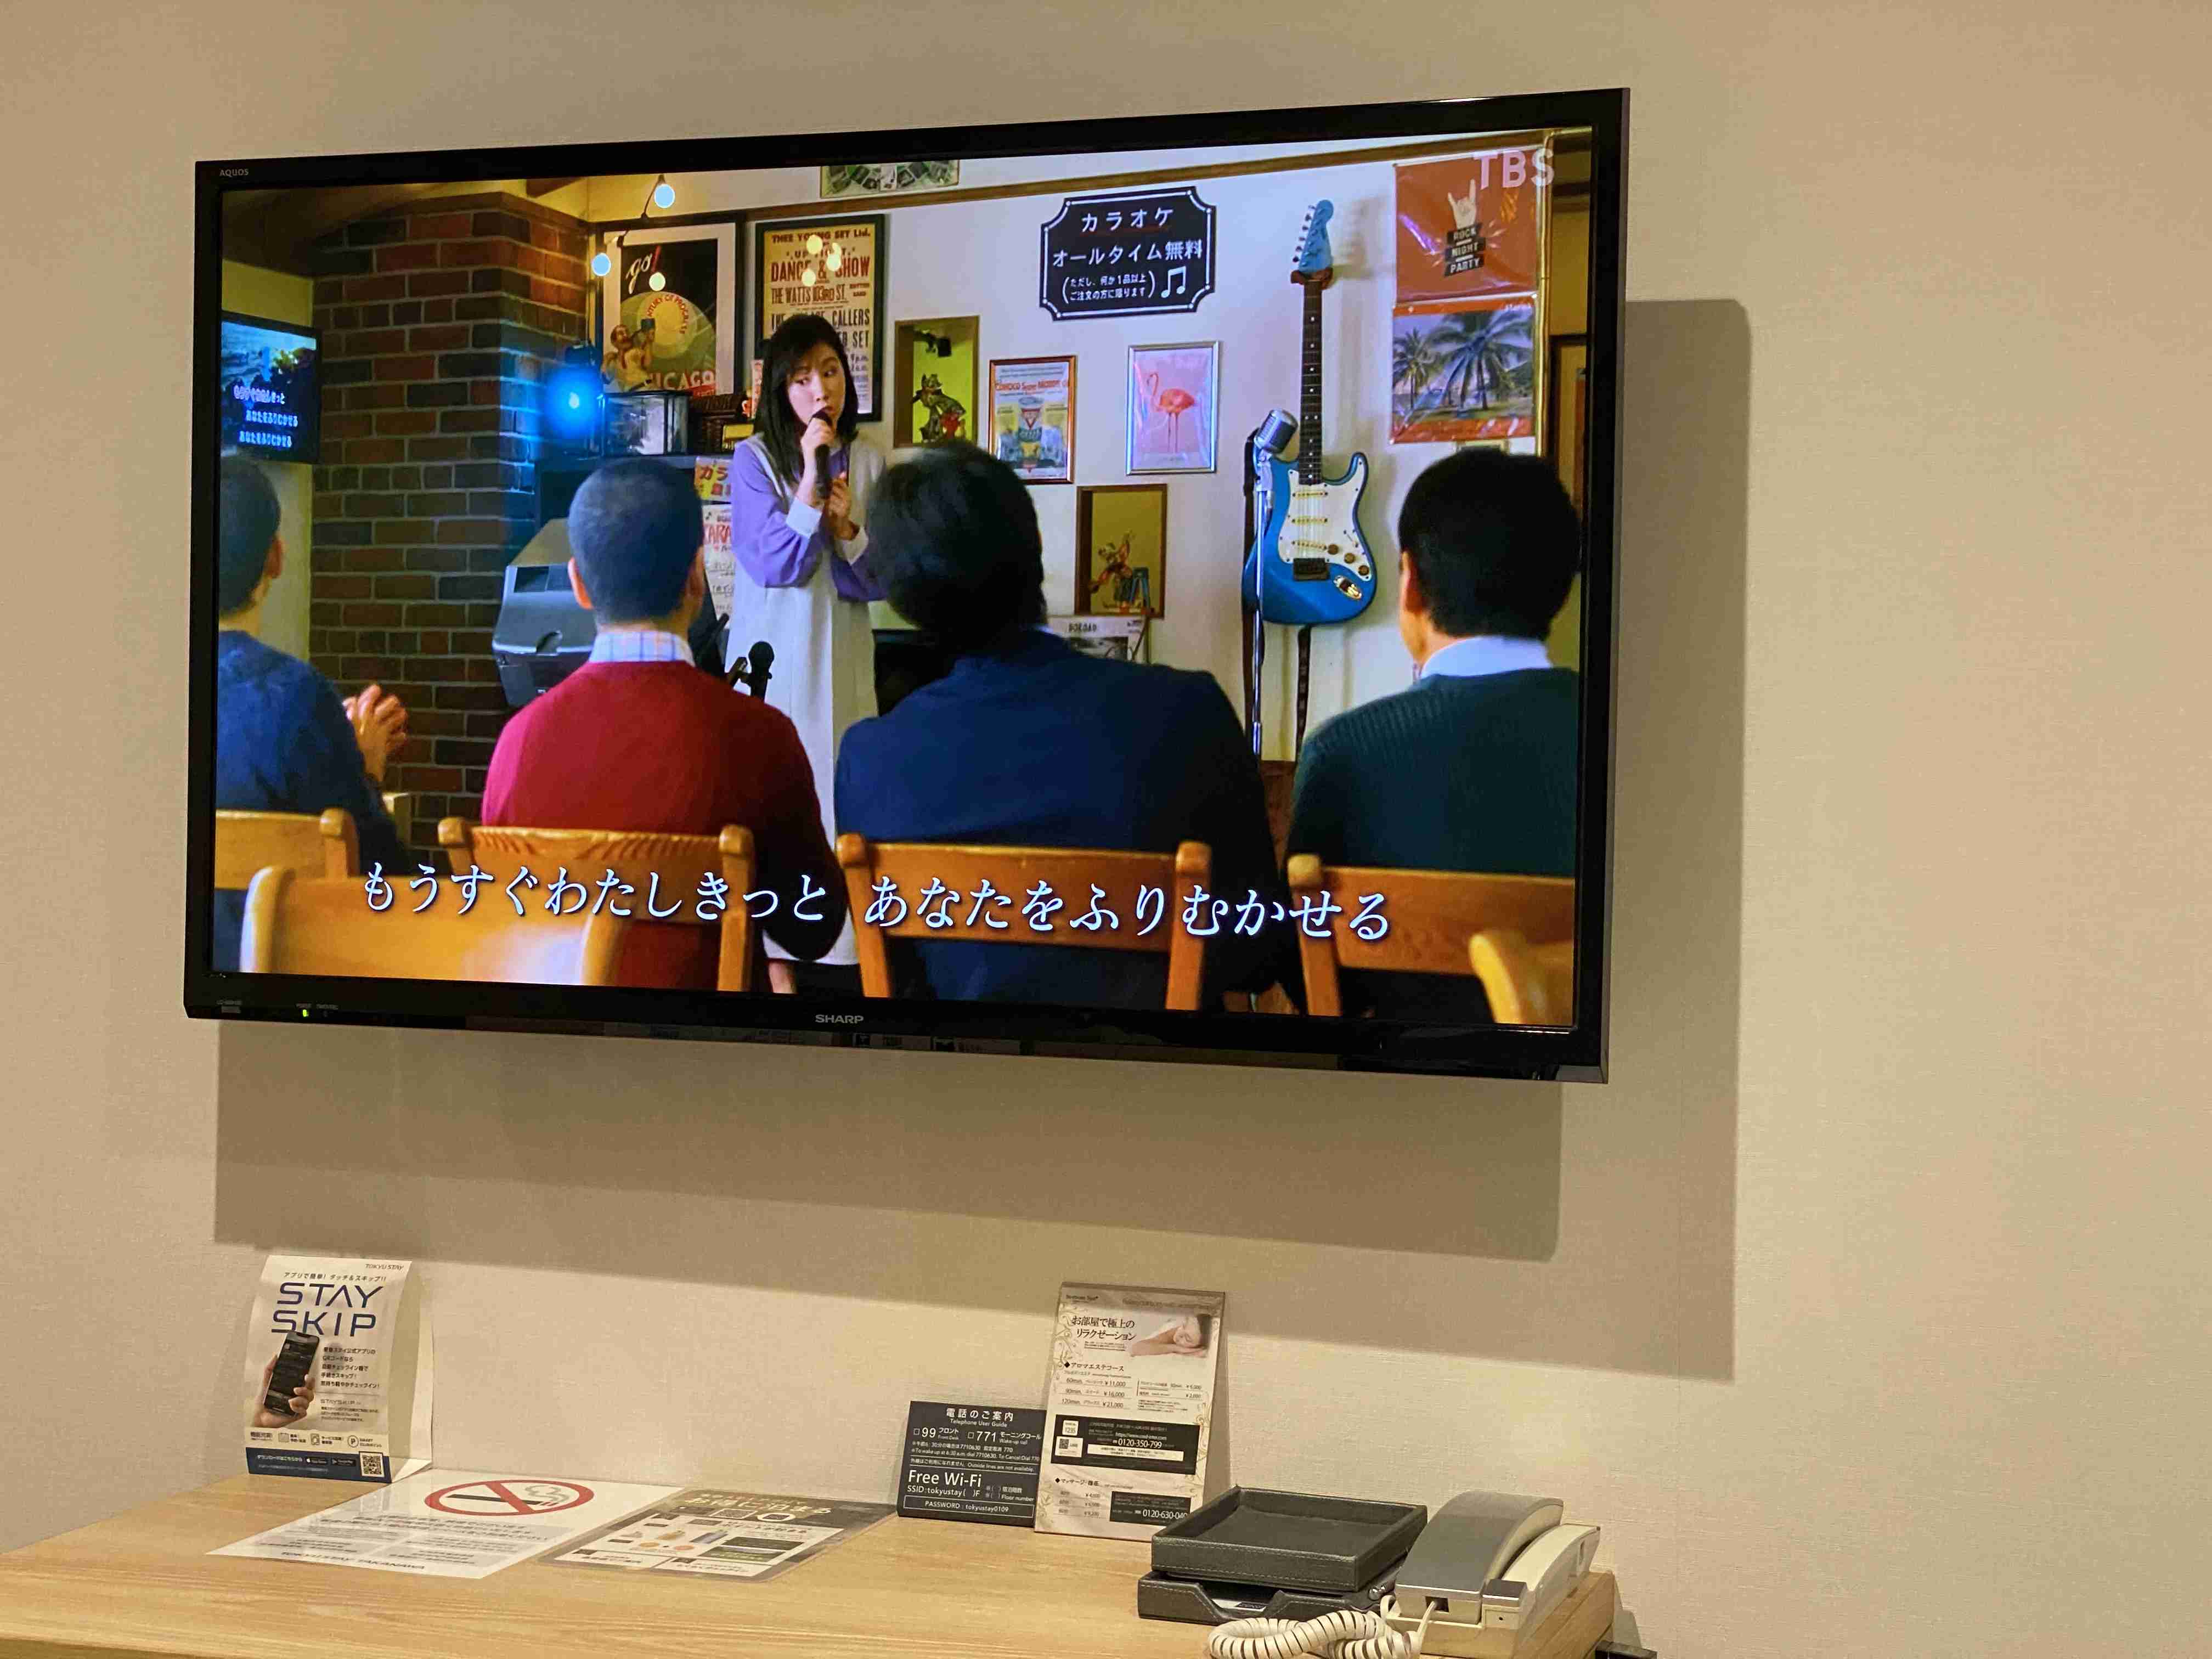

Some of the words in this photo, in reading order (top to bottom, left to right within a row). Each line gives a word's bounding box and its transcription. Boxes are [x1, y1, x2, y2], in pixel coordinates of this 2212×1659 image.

[219, 168, 249, 178] AQUOS
[1474, 148, 1554, 190] TBS
[1082, 207, 1173, 232] カラオケ
[797, 231, 831, 242] YONG
[1053, 239, 1203, 267] オールタイム無料
[1450, 258, 1480, 274] PARTY
[785, 286, 812, 303] WATTS
[832, 308, 870, 326] CALLERS
[852, 330, 870, 347] SET
[649, 370, 715, 390] ICAGO
[364, 861, 827, 921] もうすぐわたしきっと
[864, 875, 1389, 940] あなたをふりむかせる
[815, 1014, 864, 1024] SHARP
[277, 1282, 383, 1308] STAY
[272, 1310, 376, 1337] SKIP
[1071, 1316, 1135, 1329] お部屋で極上の
[1076, 1328, 1136, 1341] リラクゼーション
[946, 1408, 1014, 1422] 電話のご案内
[950, 1418, 977, 1426] Telephone
[922, 1427, 936, 1438] 99
[977, 1431, 996, 1442] 771
[1000, 1431, 1041, 1440] モーニングコール
[1118, 1438, 1162, 1449] 0120-350-799
[908, 1469, 940, 1484] Free
[944, 1471, 982, 1487] Wi-Fi
[924, 1500, 960, 1509] PASSWORD
[965, 1504, 1009, 1513] tokyustay0109
